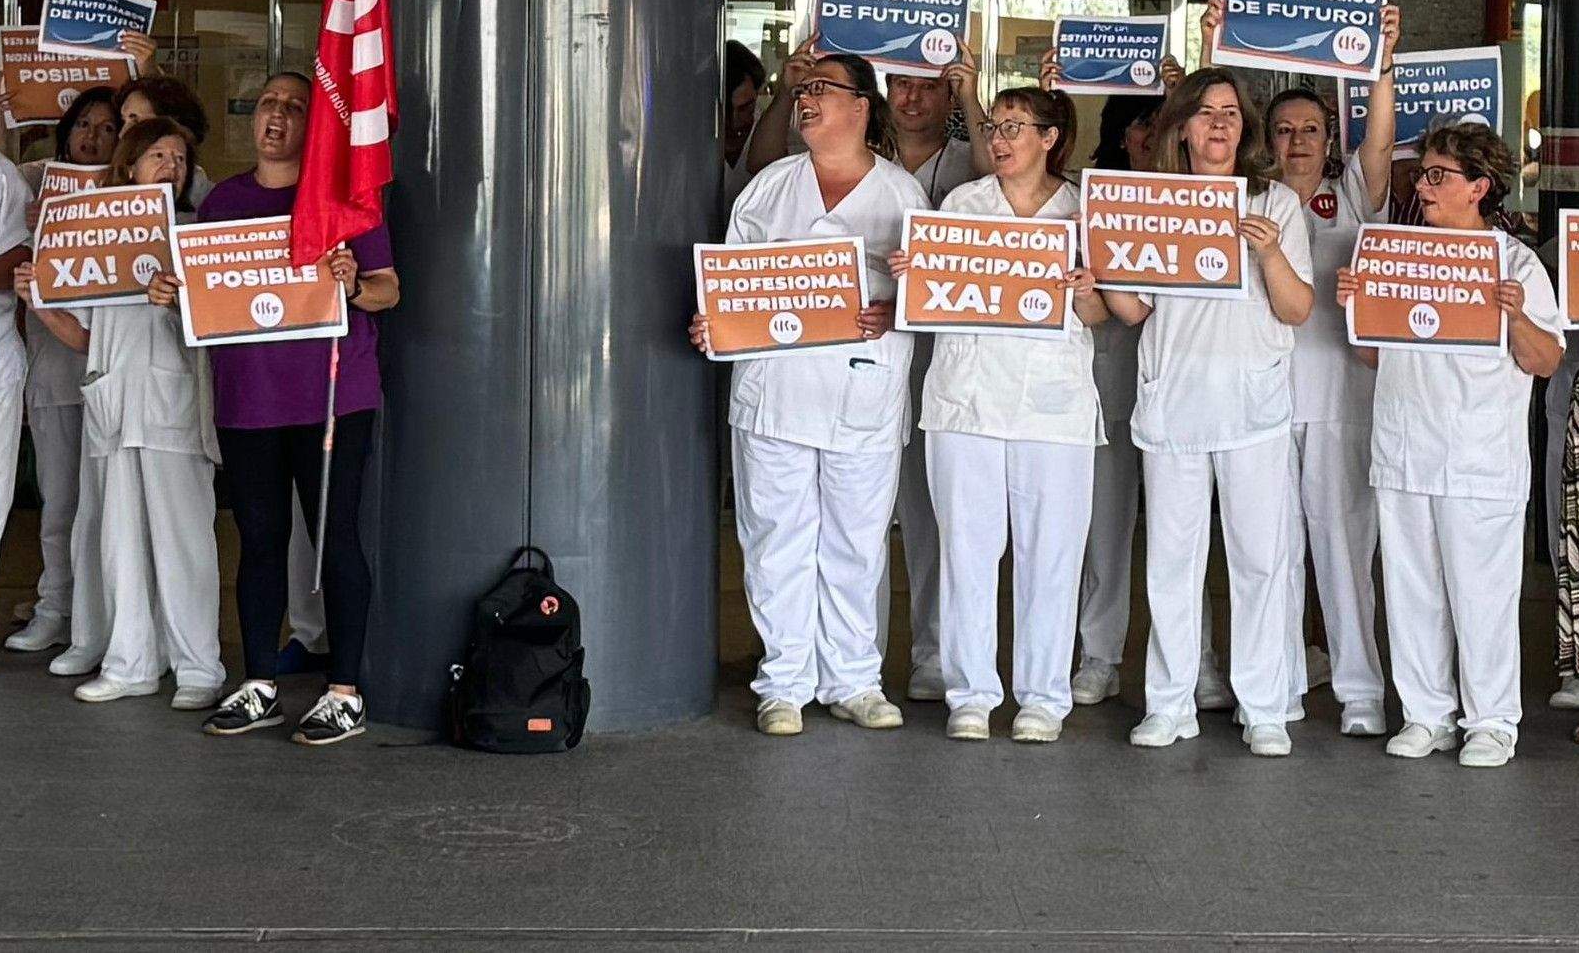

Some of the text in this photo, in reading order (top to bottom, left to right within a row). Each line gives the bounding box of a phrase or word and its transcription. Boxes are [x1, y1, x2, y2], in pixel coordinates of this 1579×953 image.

[50, 9, 72, 19] DE
[822, 2, 959, 28] DE FUTURO!
[1228, 0, 1374, 26] DE FUTURO!
[1060, 47, 1081, 57] DE
[20, 68, 110, 82] POSIBLE
[1395, 66, 1446, 78] Por un
[1433, 78, 1492, 93] MARCO
[1351, 105, 1368, 118] D
[1090, 183, 1234, 208] XUBILACIÓN
[45, 195, 162, 224] XUBILACIÓN
[1089, 211, 1235, 237] ANTICIPADA
[39, 226, 165, 249] ANTICIPADA
[210, 230, 286, 245] MELLORAS
[911, 223, 1064, 251] XUBILACIÓN
[1362, 237, 1493, 260] CLASIFICACIÓN
[185, 252, 220, 266] NON
[223, 250, 251, 262] HAI
[704, 250, 852, 271] CLASIFICACIÓN
[911, 253, 1064, 280] ANTICIPADA
[1105, 240, 1178, 275] XA!
[50, 256, 118, 288] XA!
[206, 265, 318, 289] POSIBLE
[1357, 258, 1495, 283] PROFESIONAL
[705, 273, 854, 293] PROFESIONAL
[1365, 281, 1486, 305] RETRIBUÍDA
[718, 291, 846, 312] RETRIBUÍDA
[923, 280, 1002, 315] XA!
